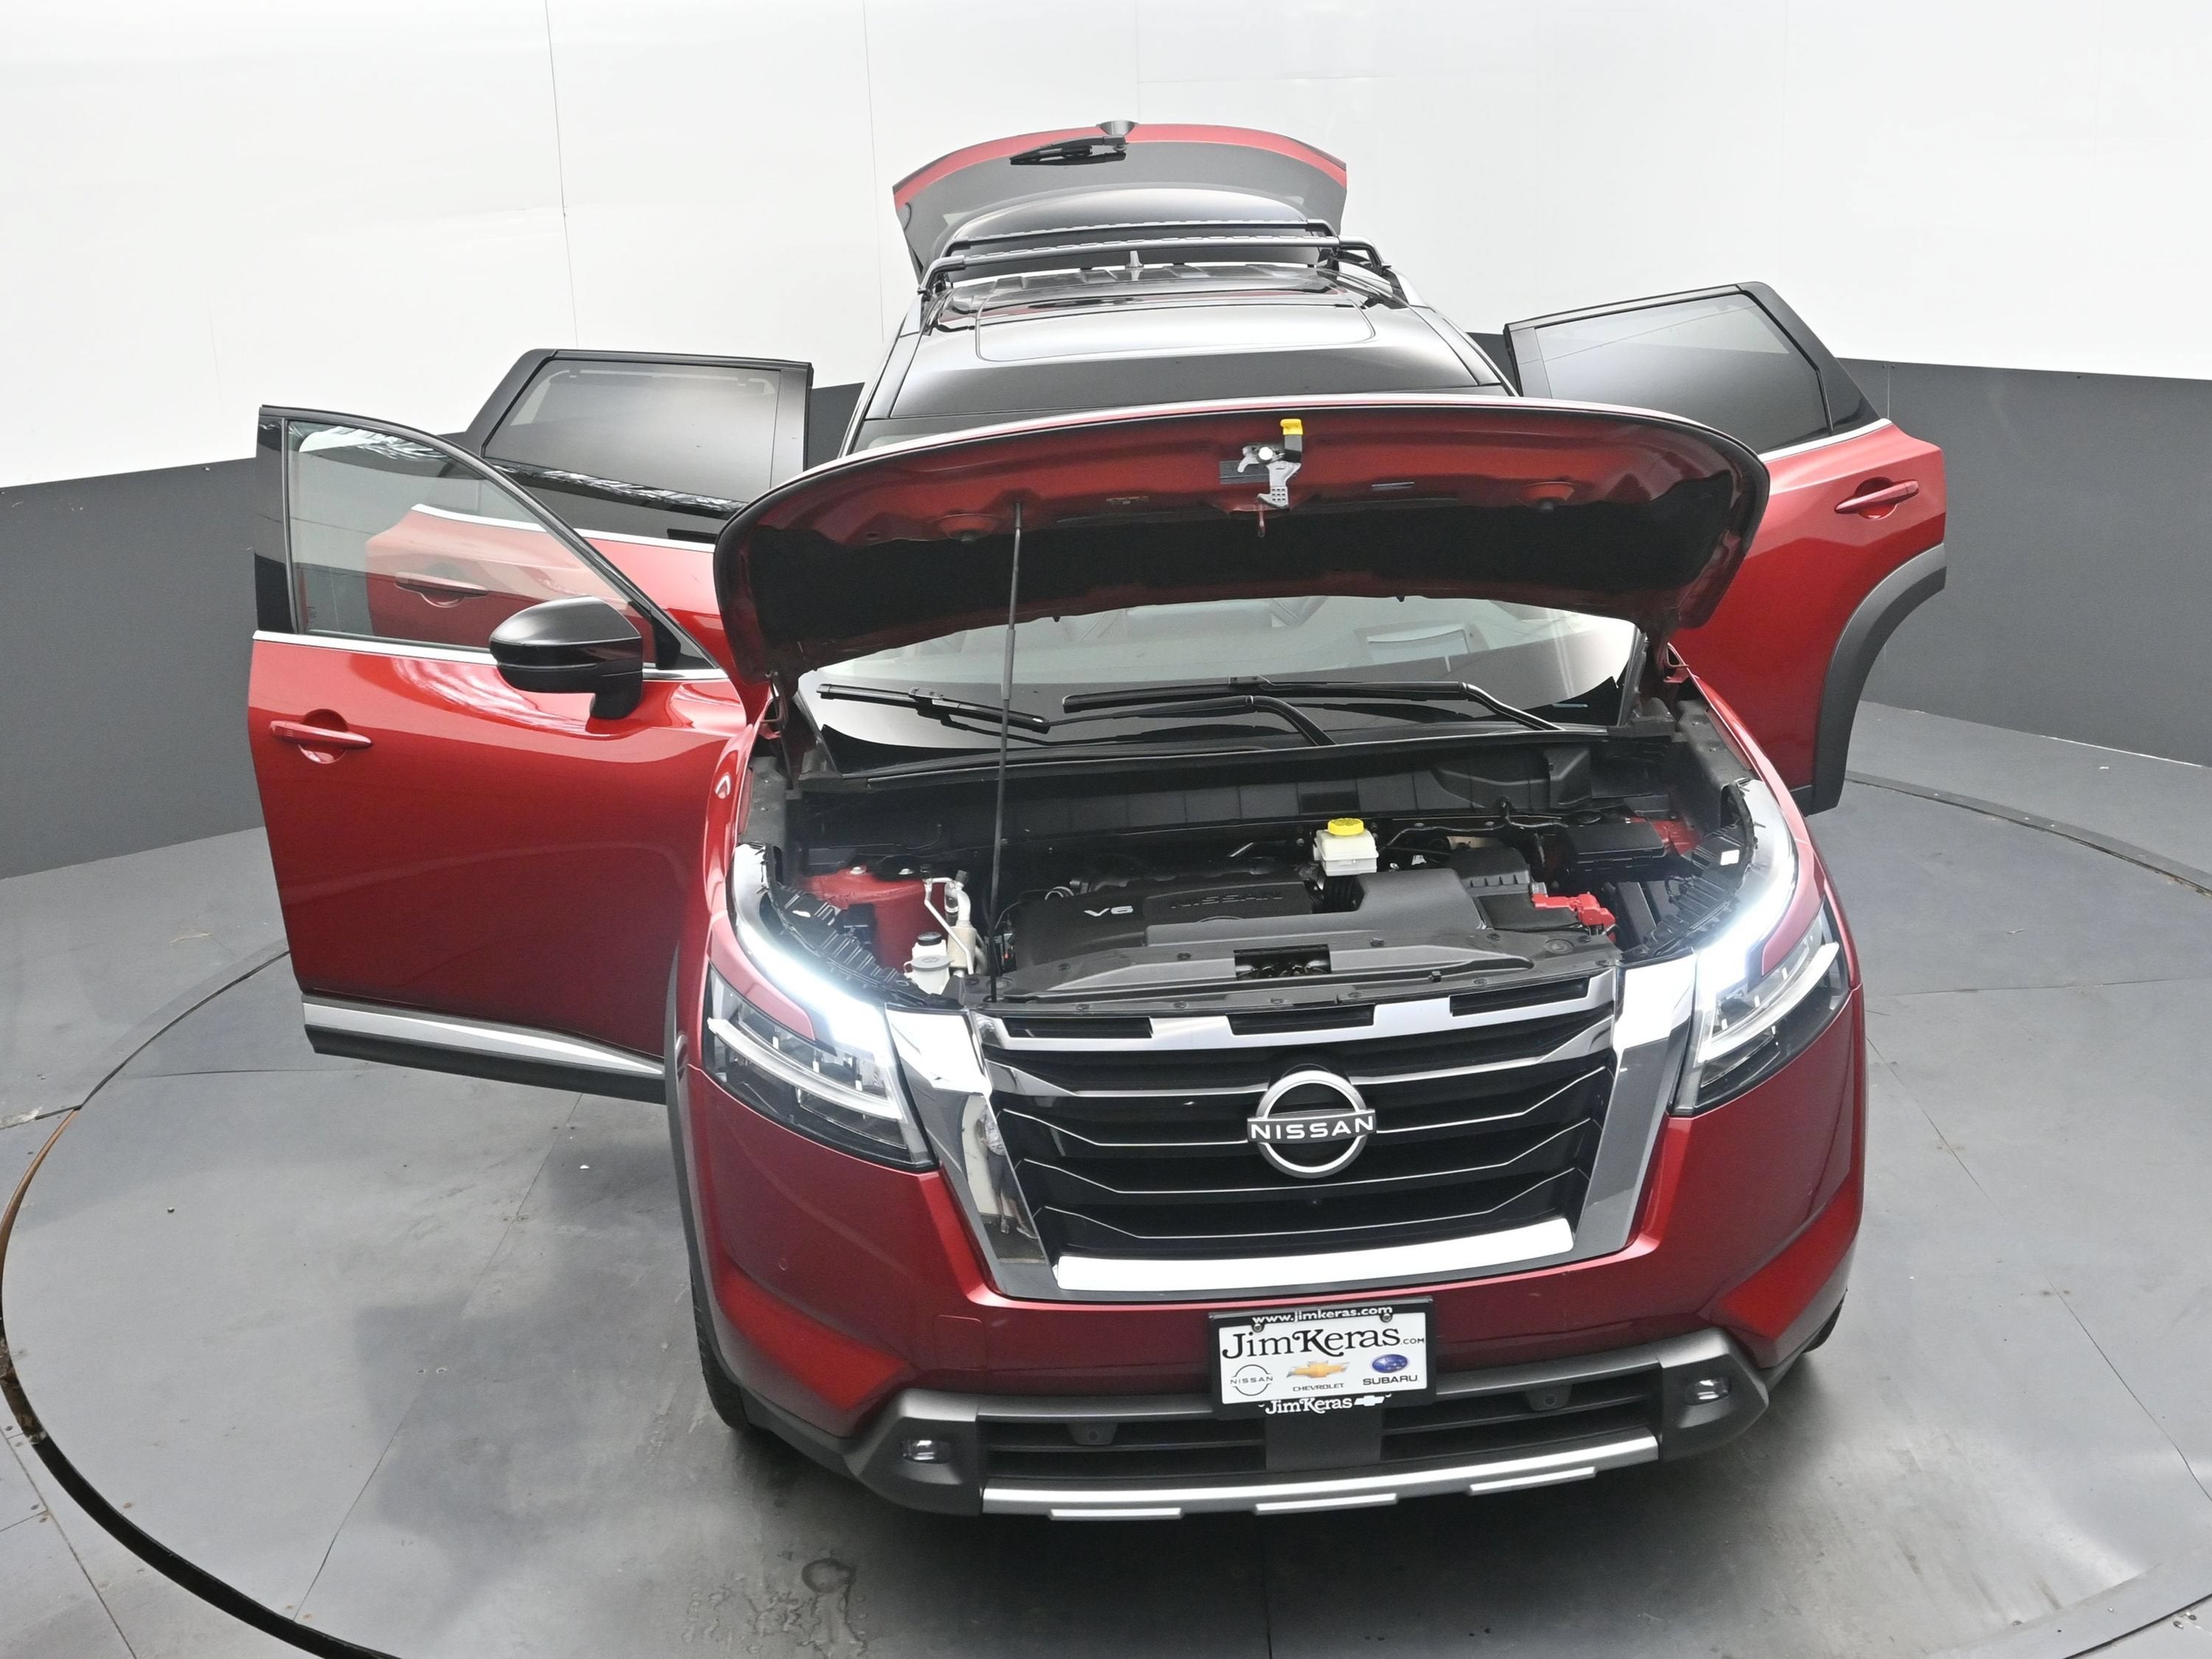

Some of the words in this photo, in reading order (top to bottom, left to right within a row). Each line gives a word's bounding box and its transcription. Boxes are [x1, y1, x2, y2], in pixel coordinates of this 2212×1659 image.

[1083, 905, 1133, 917] V6
[1251, 1116, 1374, 1139] NISSAN
[1252, 1306, 1393, 1324] www.jimkeras.com
[1230, 1376, 1273, 1385] NISSAN
[1363, 1374, 1418, 1385] SUBARU
[1293, 1382, 1344, 1392] CHEVROLET
